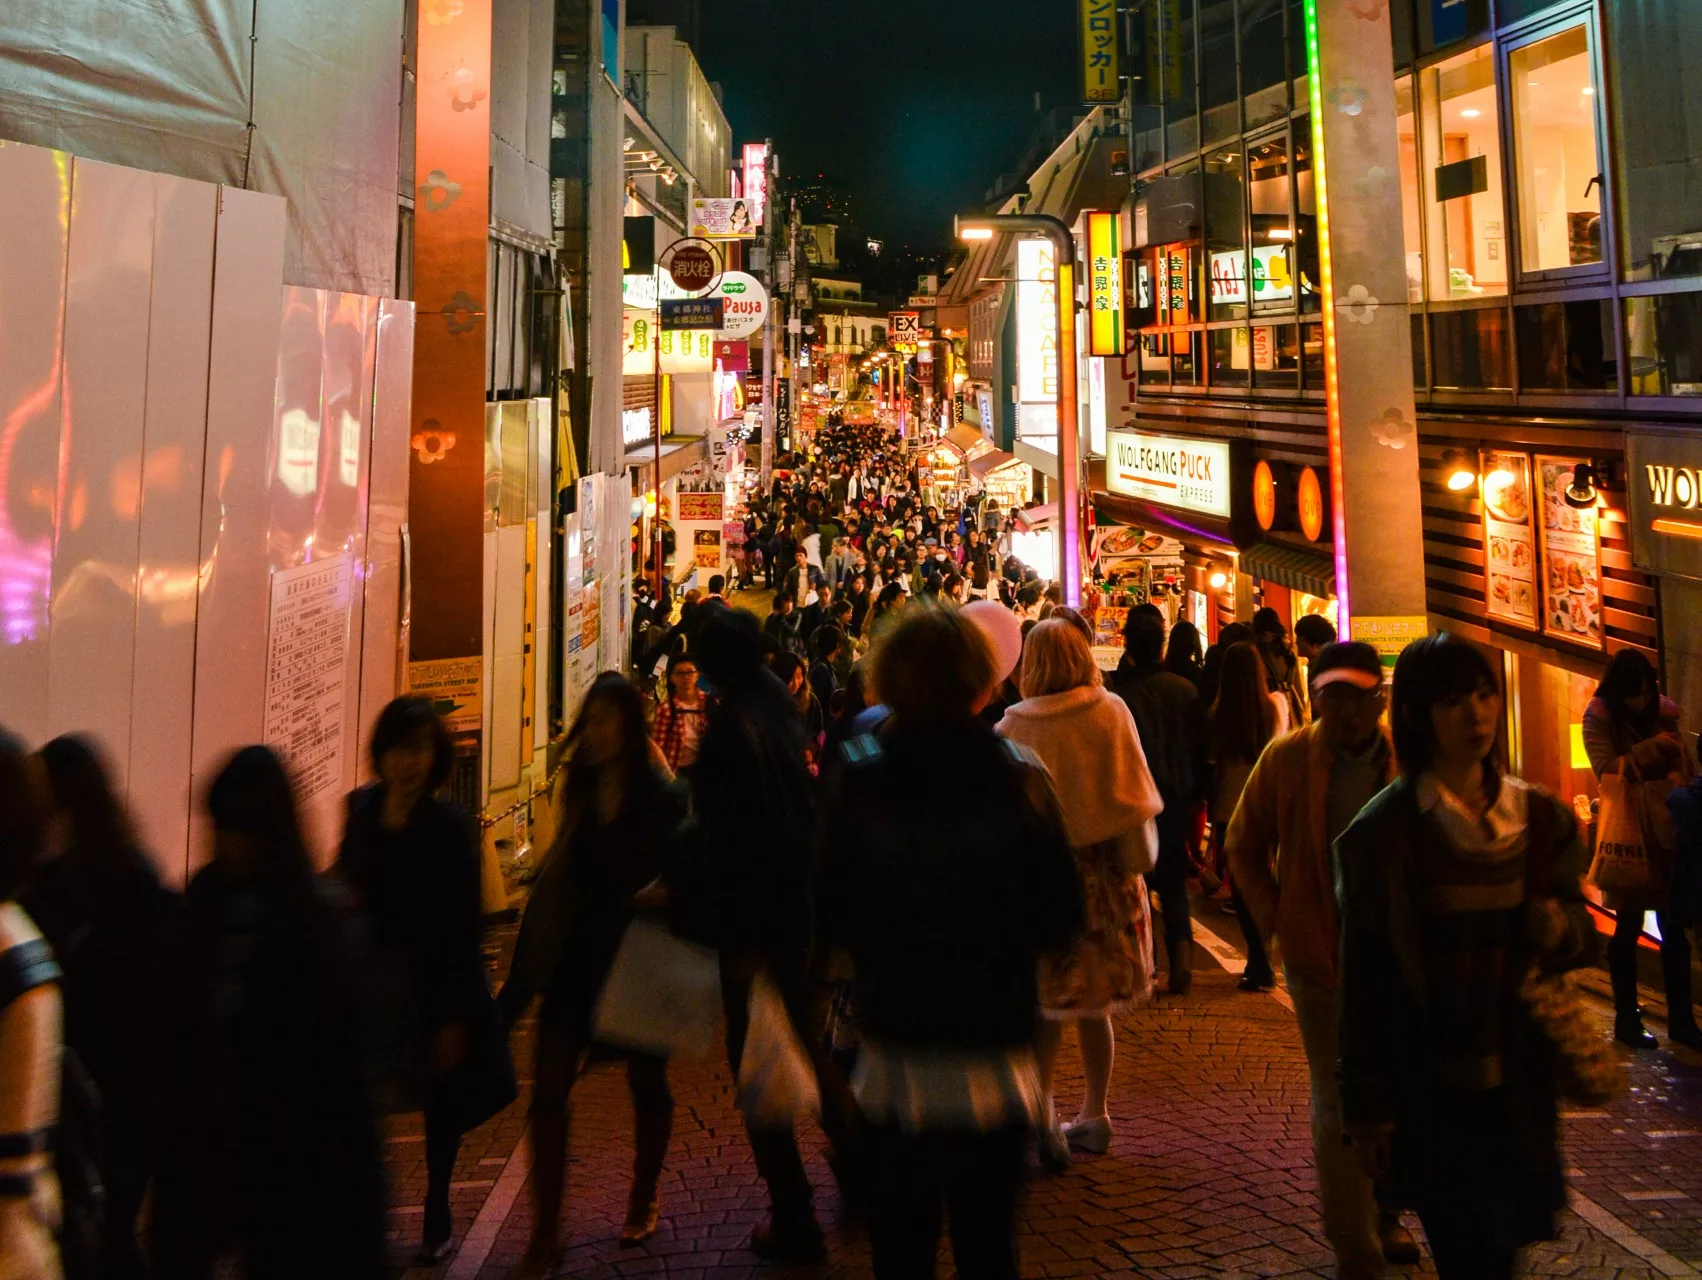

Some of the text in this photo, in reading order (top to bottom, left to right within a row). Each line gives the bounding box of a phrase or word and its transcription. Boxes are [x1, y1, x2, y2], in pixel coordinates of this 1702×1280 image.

[674, 260, 711, 278] 消火栓
[1094, 256, 1108, 311] 吉野家
[673, 304, 712, 314] 東郷神社
[896, 317, 917, 331] EX
[895, 333, 918, 341] LIVE
[1117, 442, 1212, 481] WOLFGANG PUCK
[1180, 484, 1213, 503] EXPRESS
[1645, 464, 1702, 510] WO
